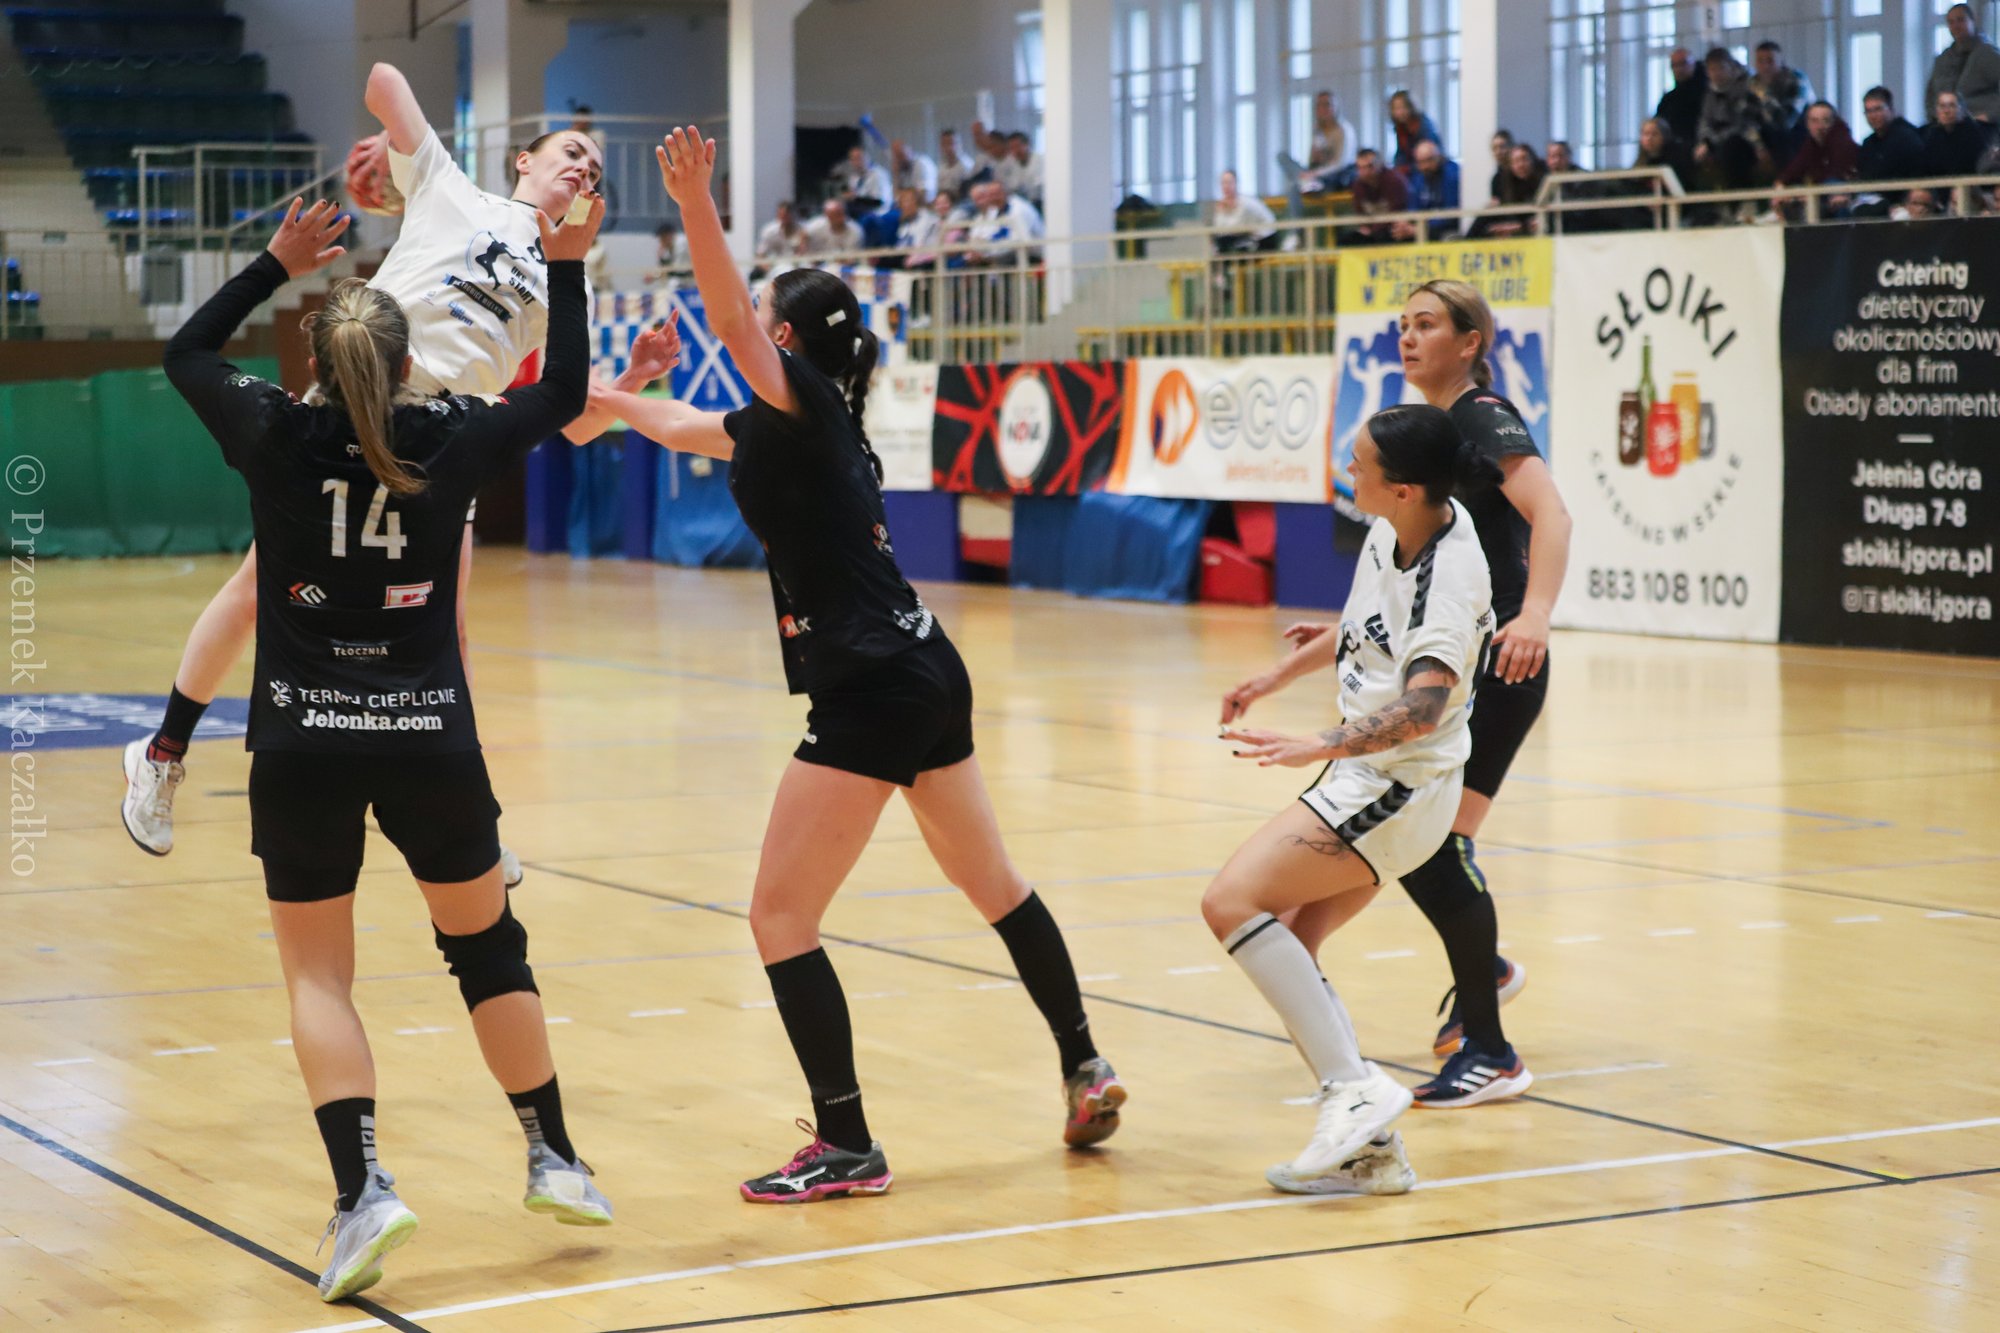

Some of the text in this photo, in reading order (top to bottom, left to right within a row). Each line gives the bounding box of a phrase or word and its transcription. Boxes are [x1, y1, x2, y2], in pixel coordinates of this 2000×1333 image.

[1368, 251, 1524, 278] WSZYSCY GRAMY
[1877, 257, 1969, 290] Catering
[508, 277, 536, 305] START
[1597, 267, 1737, 361] SŁOIKI
[1858, 292, 1985, 324] dietetyczny
[1877, 355, 1957, 384] dla firm
[1203, 376, 1319, 450] eco
[1804, 388, 2000, 421] Obiady abonament
[1852, 460, 1982, 490] Jelenia Góra
[321, 478, 407, 560] 14
[1863, 496, 1967, 530] Długa 7-8
[1588, 568, 1748, 606] 883 108 100
[333, 646, 389, 657] TŁOCZNIA
[1342, 673, 1363, 695] START
[302, 709, 443, 731] Jelonka.com
